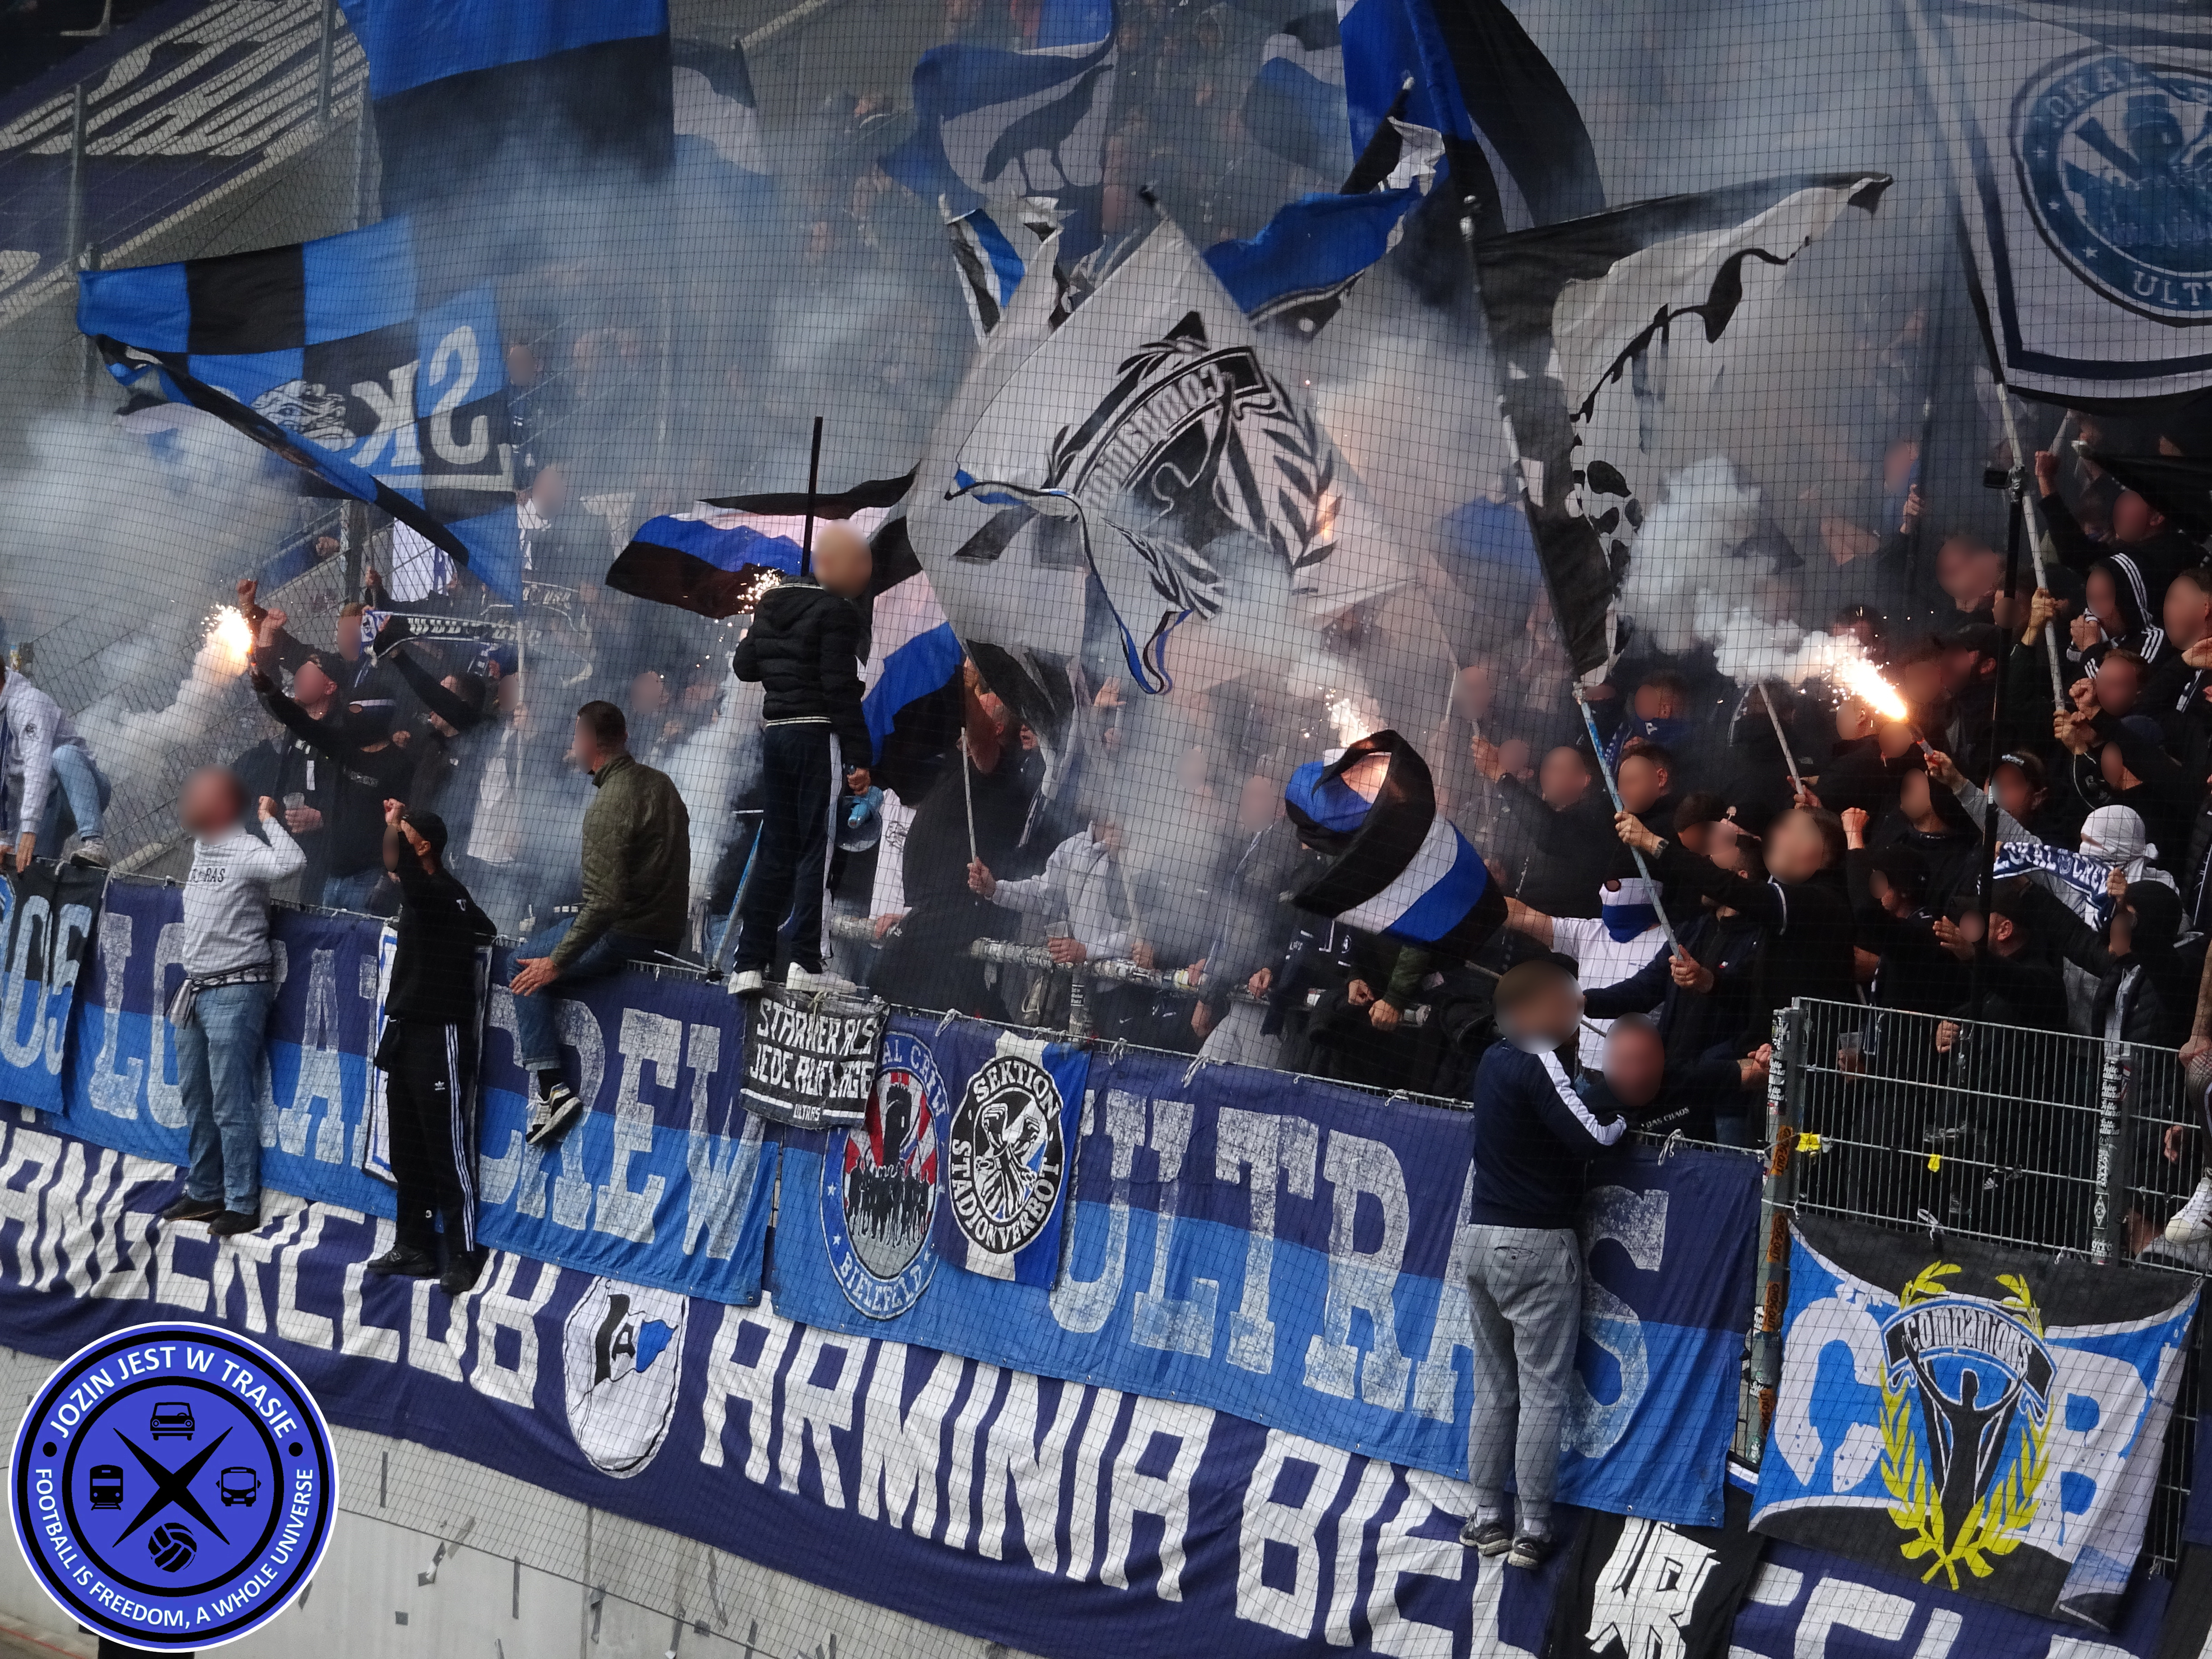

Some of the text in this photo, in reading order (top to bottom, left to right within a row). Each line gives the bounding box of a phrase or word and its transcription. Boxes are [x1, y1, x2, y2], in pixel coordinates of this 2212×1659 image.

[757, 998, 841, 1054] STÄRKER
[839, 1018, 879, 1056] ALS
[750, 1043, 876, 1099] JEDE AUFLAGE
[973, 1060, 1061, 1120] SEKTION
[793, 1103, 821, 1121] ULTRAS
[1646, 1106, 1690, 1129] DAS CHAOS
[951, 1139, 1059, 1250] STADIONVERBOT
[700, 1290, 1216, 1602] ARMINIA
